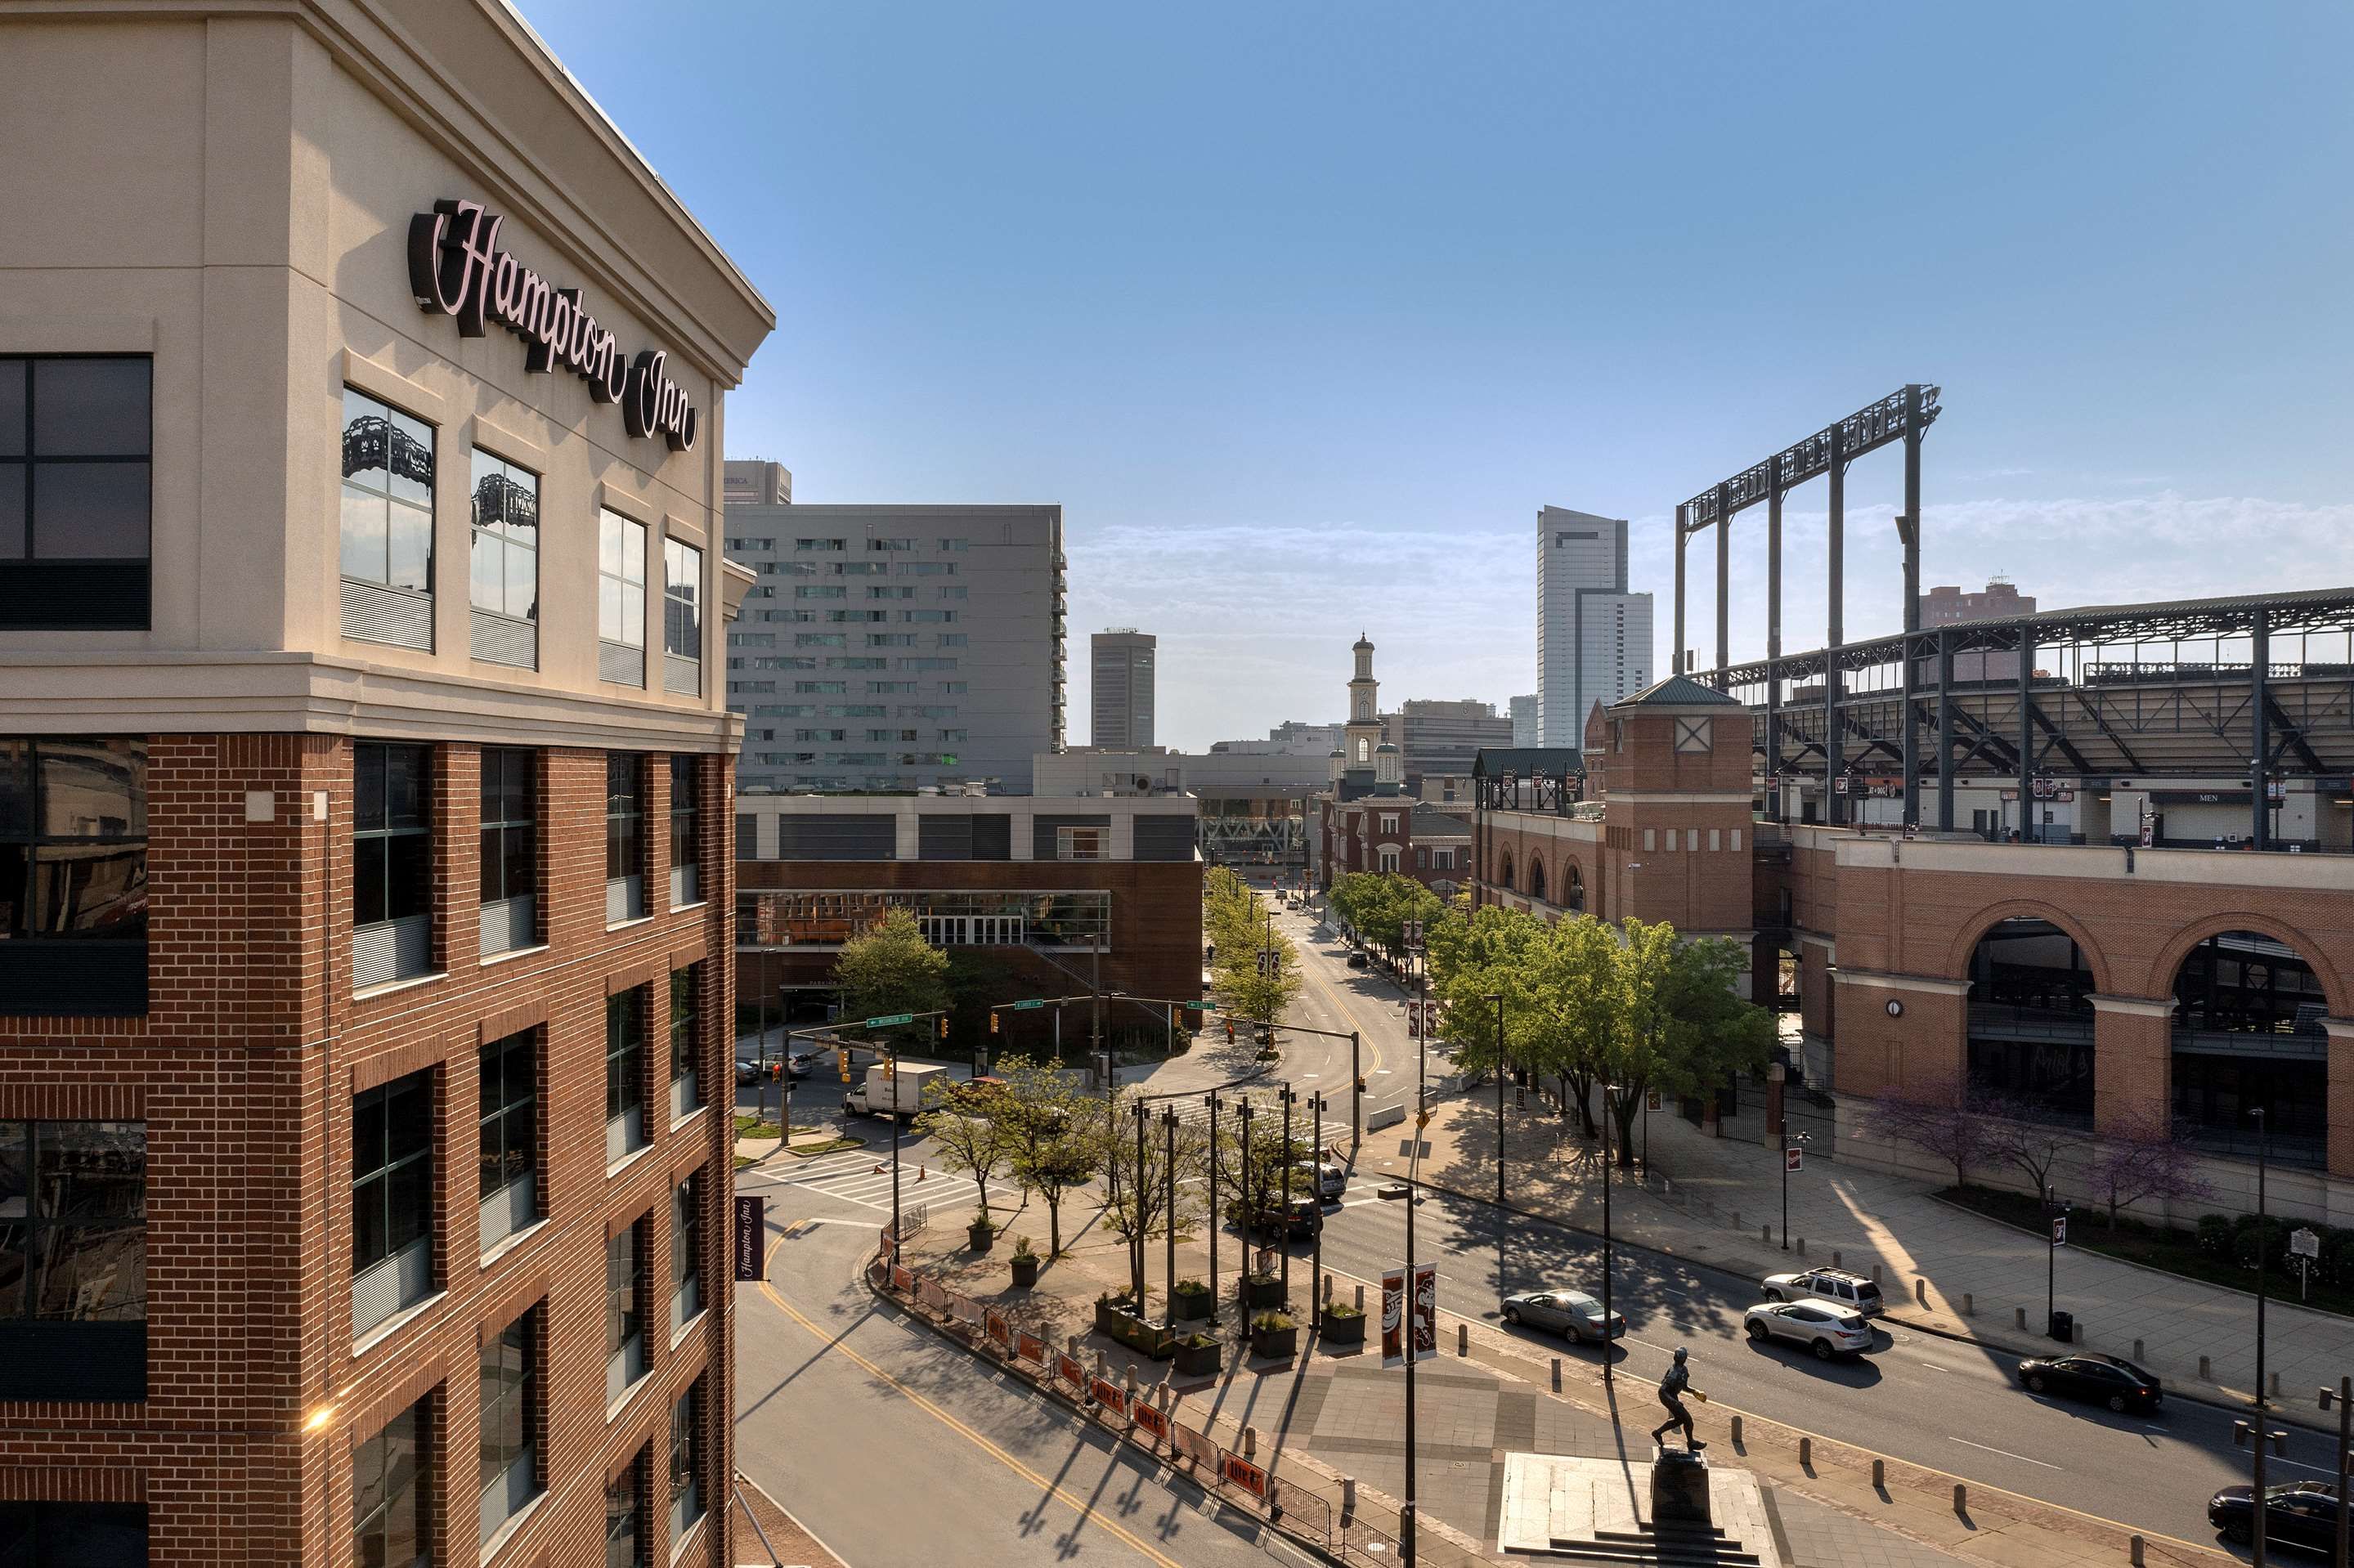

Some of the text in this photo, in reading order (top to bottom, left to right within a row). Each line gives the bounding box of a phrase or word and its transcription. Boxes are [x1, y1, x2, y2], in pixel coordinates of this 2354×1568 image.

[433, 199, 698, 452] Hampton Inn
[740, 1199, 753, 1278] Hampton Inn
